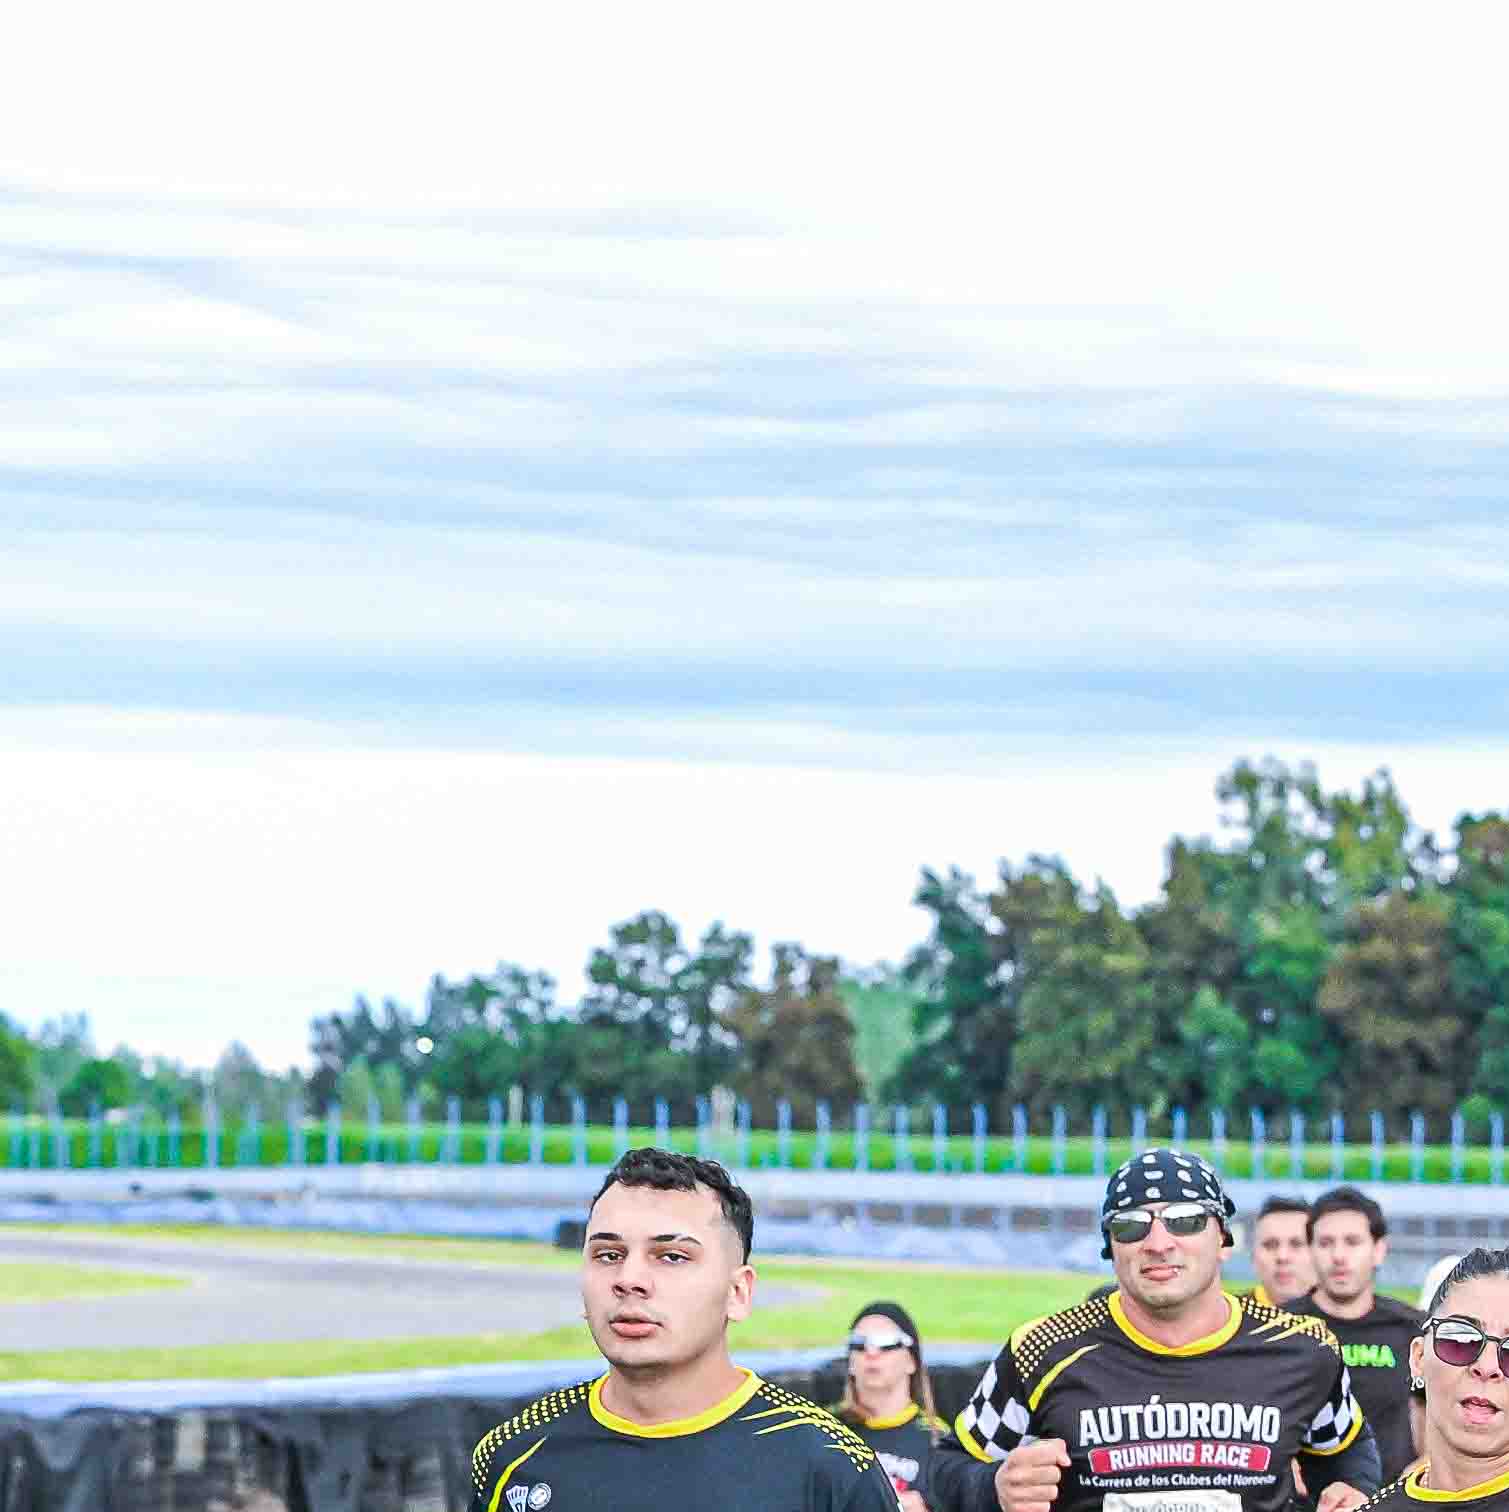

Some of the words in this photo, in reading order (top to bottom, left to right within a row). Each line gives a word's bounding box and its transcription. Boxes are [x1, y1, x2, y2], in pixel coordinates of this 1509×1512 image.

[1344, 1344, 1397, 1368] UMA
[1080, 1394, 1280, 1446] AUTÓDROMO
[1109, 1444, 1195, 1471] RUNNING
[1200, 1444, 1251, 1466] RACE
[1080, 1475, 1091, 1485] La
[1093, 1476, 1132, 1487] Carrera
[1134, 1475, 1150, 1486] de
[1152, 1474, 1169, 1486] los
[1172, 1474, 1211, 1486] Clubes
[1213, 1474, 1232, 1485] del
